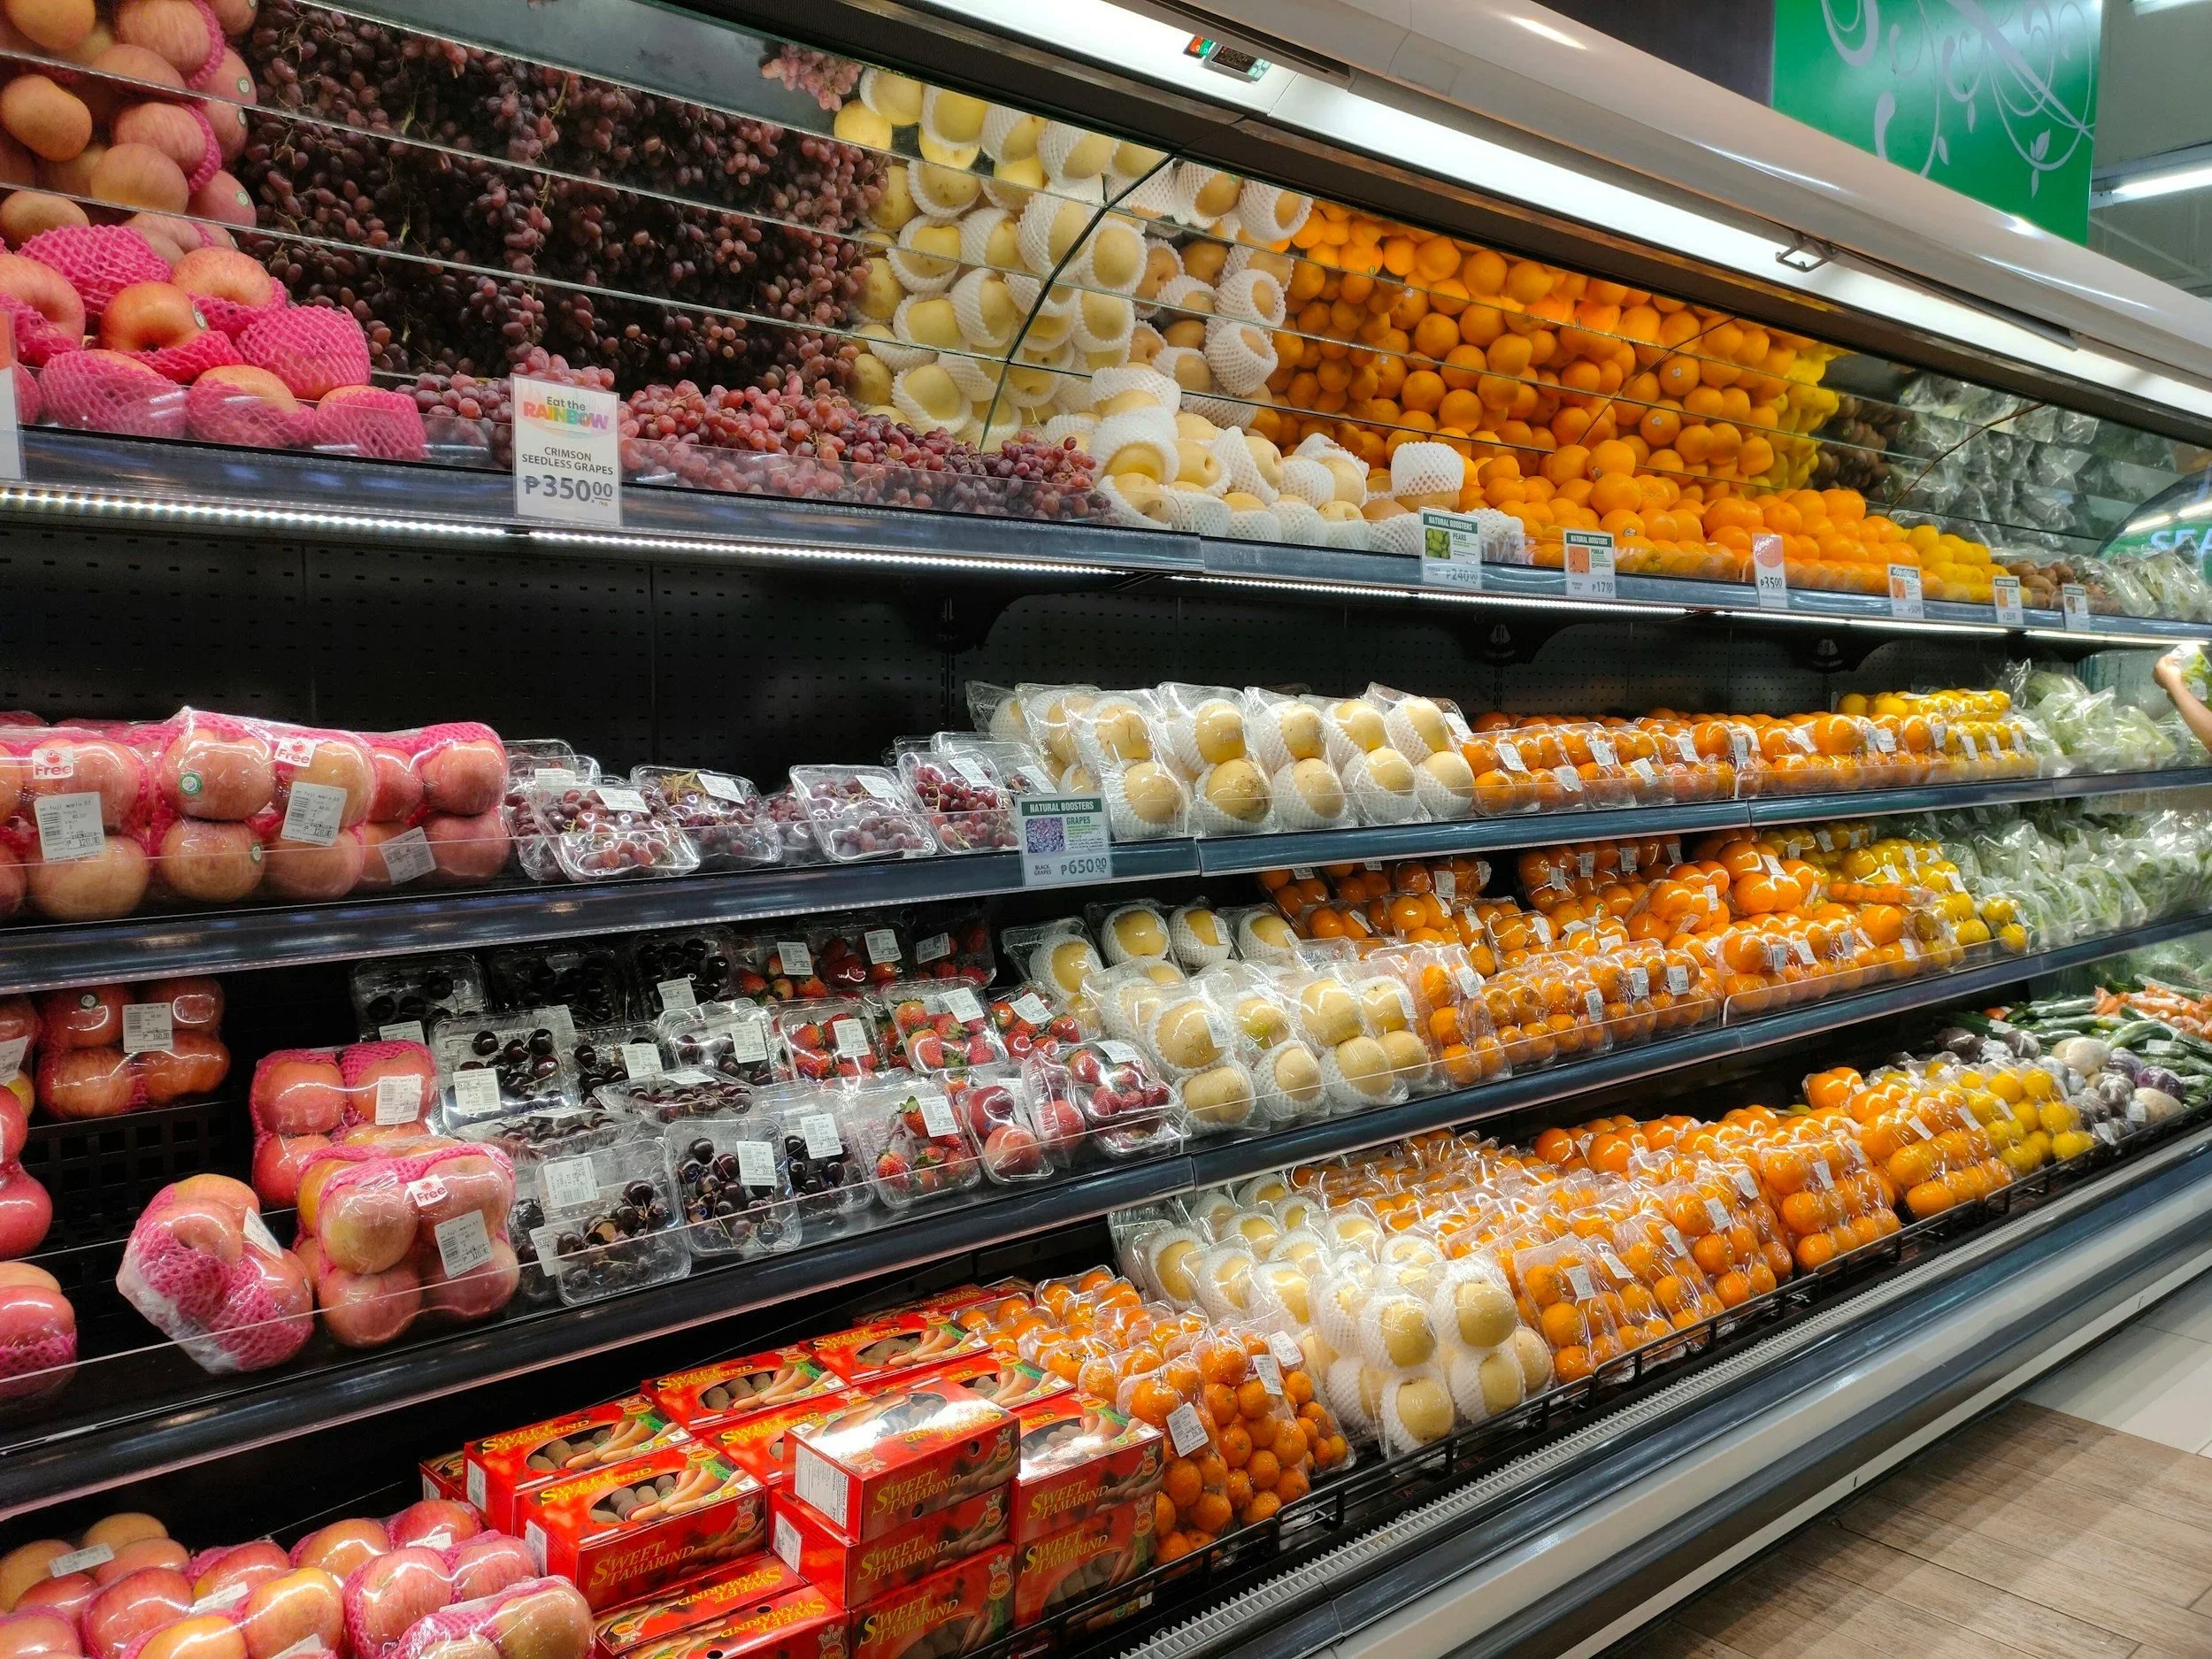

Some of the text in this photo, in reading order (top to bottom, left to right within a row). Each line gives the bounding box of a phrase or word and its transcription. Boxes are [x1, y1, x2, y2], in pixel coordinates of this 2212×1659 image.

[523, 401, 610, 430] RAINBOW
[547, 396, 586, 411] Eat the
[522, 453, 614, 476] SEEDLESS GRAPES
[544, 446, 592, 462] CRIMSON
[1428, 516, 1473, 531] NATURAL BOOSTERS
[1452, 533, 1467, 541] PEARS
[1570, 534, 1609, 545] NATURAL BOOSTERS
[35, 764, 72, 776] Free
[278, 748, 311, 764] Free
[1029, 801, 1094, 813] NATURAL BOOSTERS
[1066, 816, 1091, 826] GRAPES
[78, 836, 100, 847] 120.00
[416, 1187, 447, 1202] Free
[813, 1327, 871, 1352] SWEET
[829, 1326, 900, 1350] TAMARIND
[657, 1365, 722, 1393] SWEET
[675, 1364, 753, 1389] TAMARIND
[482, 1422, 553, 1455] SWEET
[499, 1419, 590, 1449] TAMARIND
[720, 1416, 783, 1447] SWEET
[744, 1412, 818, 1440] TAMARIND
[540, 1470, 616, 1507] SWEET
[559, 1467, 652, 1501] TAMARIND
[871, 1468, 939, 1517] SWEET
[887, 1473, 962, 1516] TAMARIND
[1025, 1479, 1087, 1522] SWEET
[1041, 1485, 1110, 1520] TAMARIND
[588, 1540, 667, 1589] SWEET
[606, 1545, 695, 1587] TAMARIND
[856, 1533, 925, 1584] SWEET
[872, 1540, 949, 1581] TAMARIND
[1021, 1527, 1085, 1578] SWEET
[1036, 1534, 1108, 1574] TAMARIND
[678, 1571, 764, 1607] TAMARIND
[714, 1566, 783, 1604] SWEET
[720, 1600, 805, 1639] TAMARIND
[757, 1595, 827, 1634] SWEET
[858, 1593, 933, 1649] SWEET
[876, 1599, 958, 1646] TAMARIND
